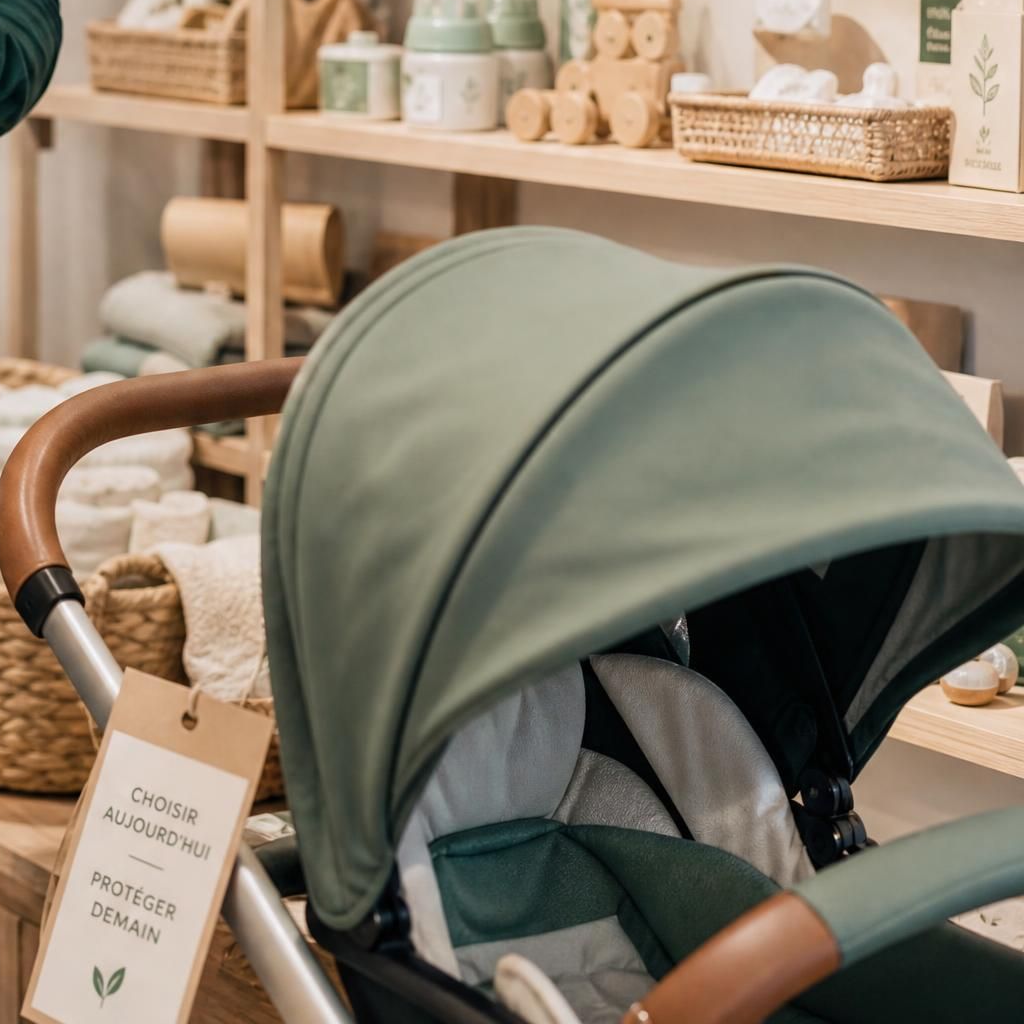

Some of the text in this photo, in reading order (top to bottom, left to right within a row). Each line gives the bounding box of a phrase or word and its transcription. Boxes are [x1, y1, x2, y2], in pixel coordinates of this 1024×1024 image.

[131, 787, 198, 825] CHOISIR
[103, 806, 211, 860] AUJOURD'HUI
[90, 872, 176, 920] PROTÉGER
[90, 901, 161, 944] DEMAIN
